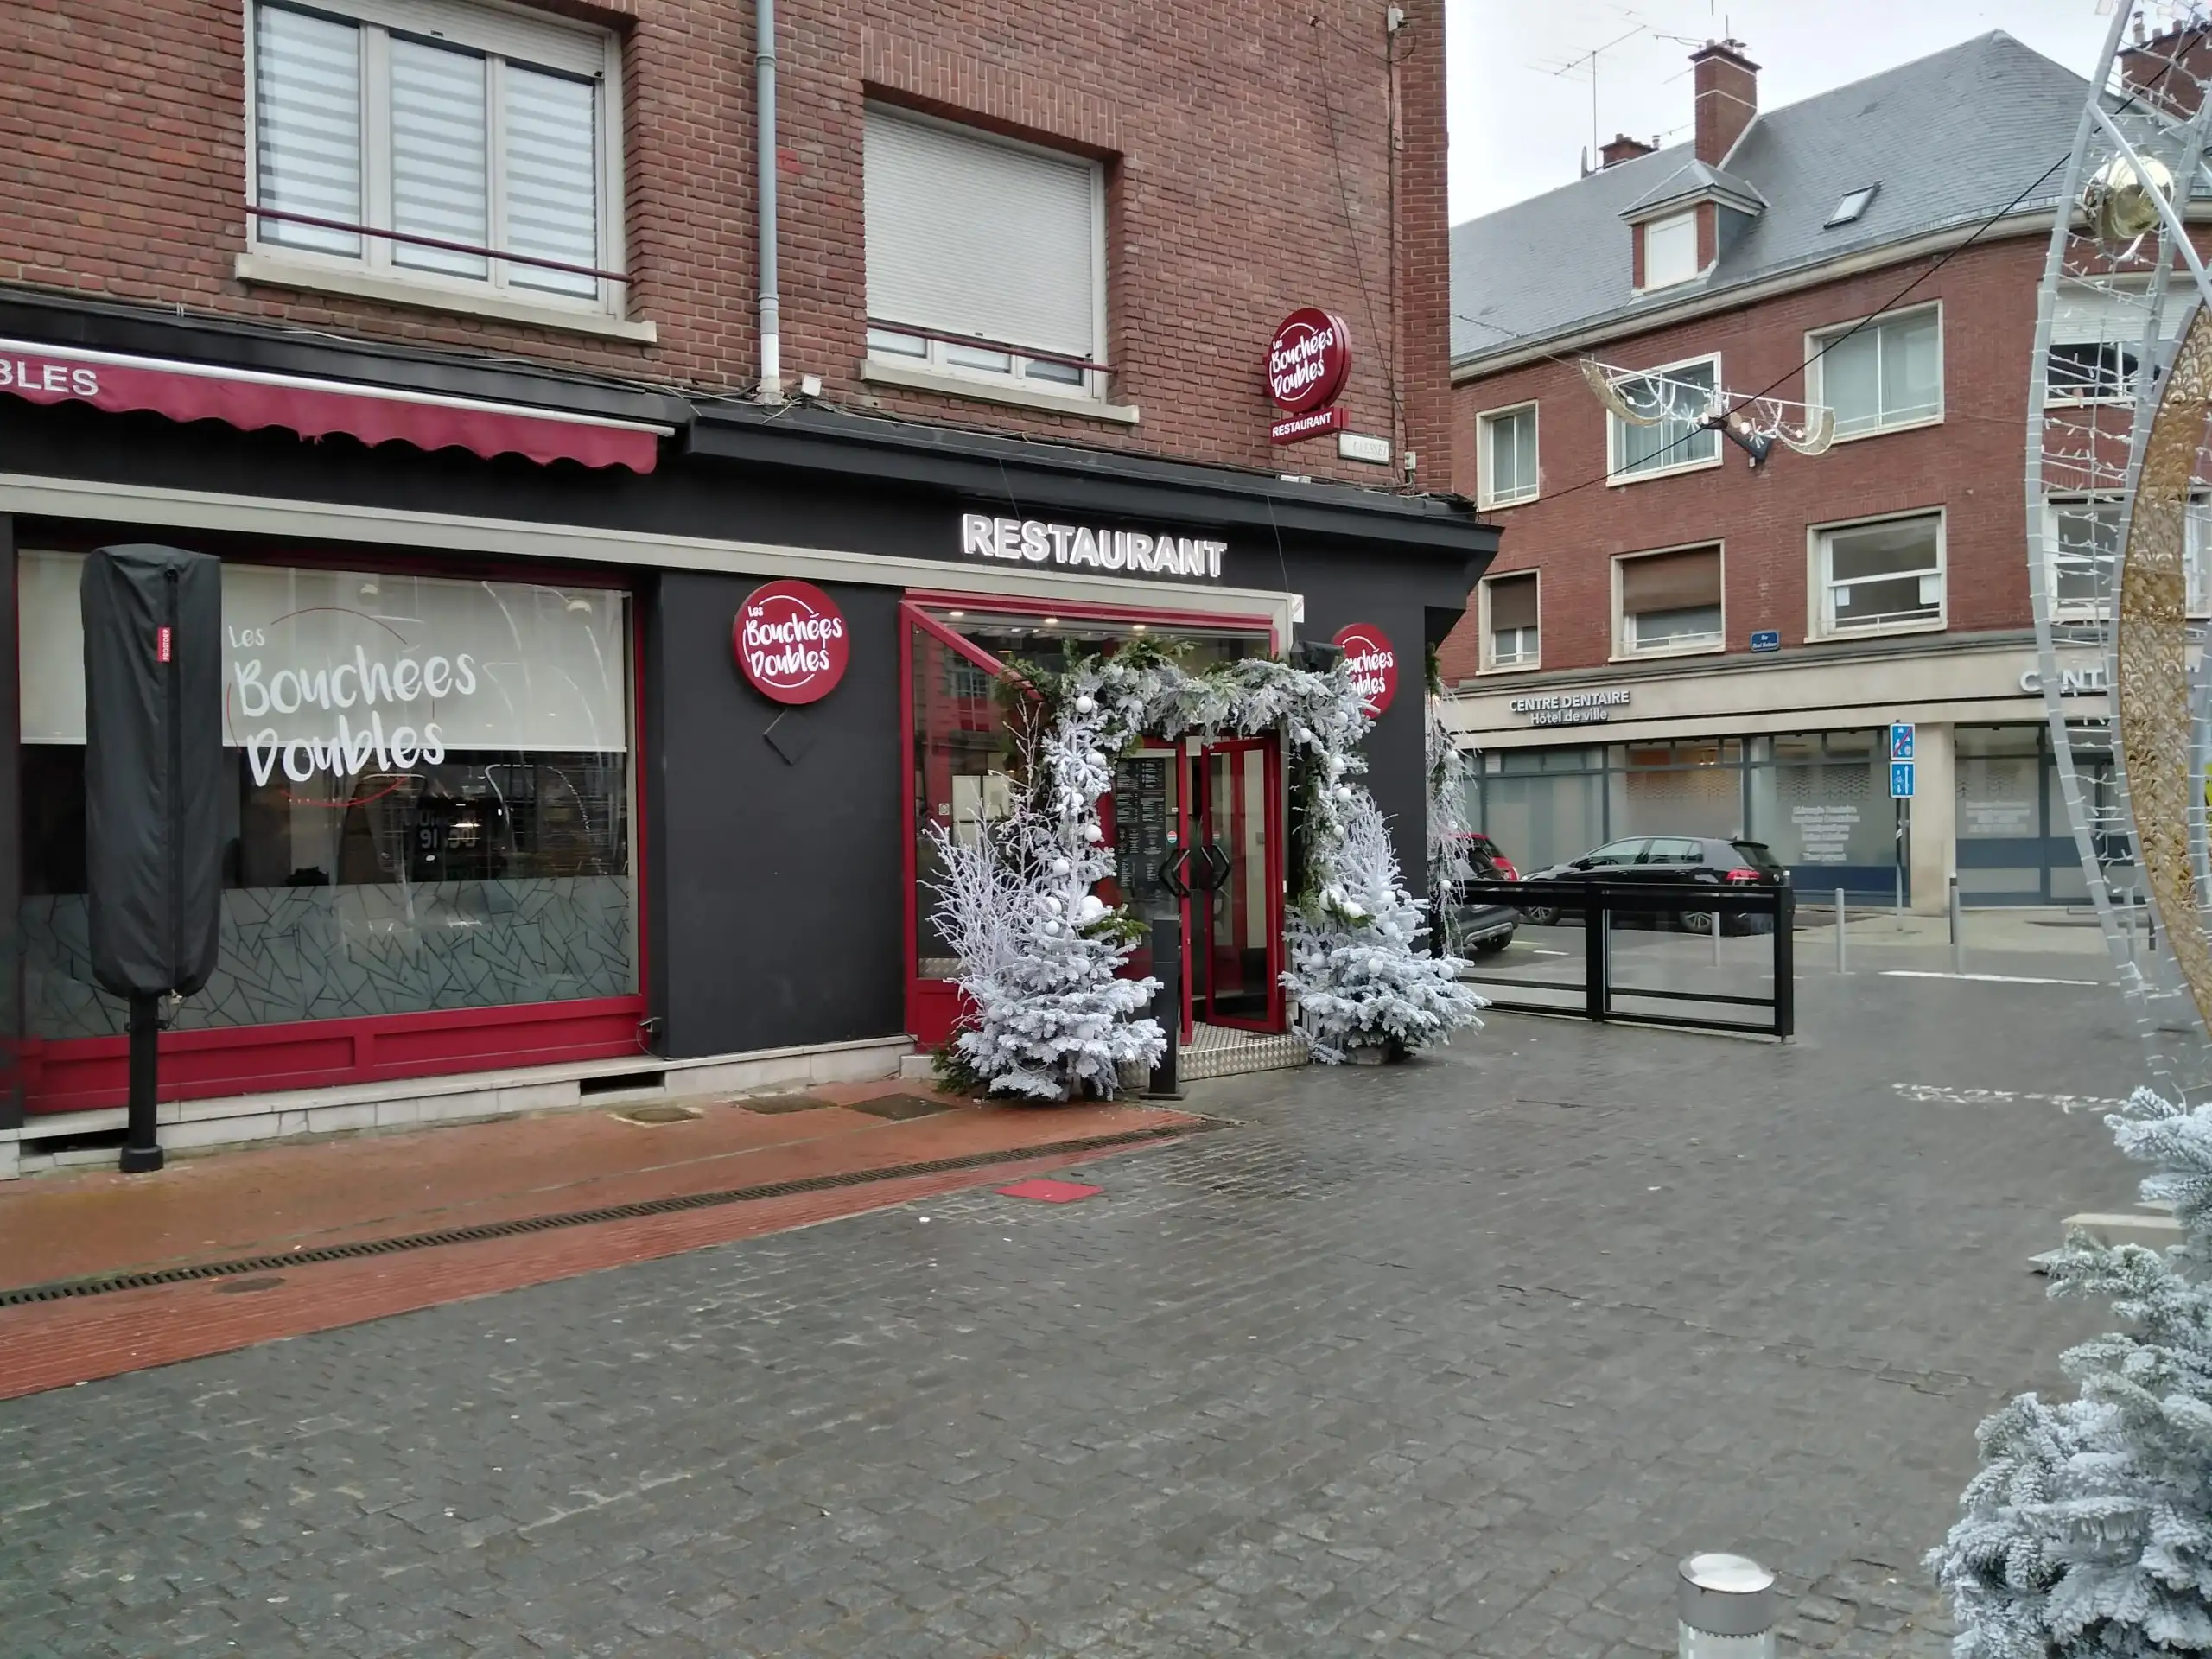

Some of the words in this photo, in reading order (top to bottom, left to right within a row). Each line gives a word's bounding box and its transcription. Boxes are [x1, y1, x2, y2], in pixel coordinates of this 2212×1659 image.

[1271, 327, 1333, 373] Bouchées
[1274, 359, 1325, 398] Doubles
[1272, 412, 1332, 438] RESTAURANT
[963, 514, 1227, 577] RESTAURANT
[228, 625, 265, 648] Les
[745, 612, 843, 646] Bouchées
[750, 643, 830, 677] Doubles
[1344, 648, 1394, 675] ouchées
[1510, 697, 1559, 712] CENTRE
[1560, 691, 1630, 708] DENTAIRE
[1530, 711, 1562, 725] Hôtel
[1563, 709, 1580, 722] de
[1582, 707, 1608, 721] ville
[246, 710, 446, 787] Doubles
